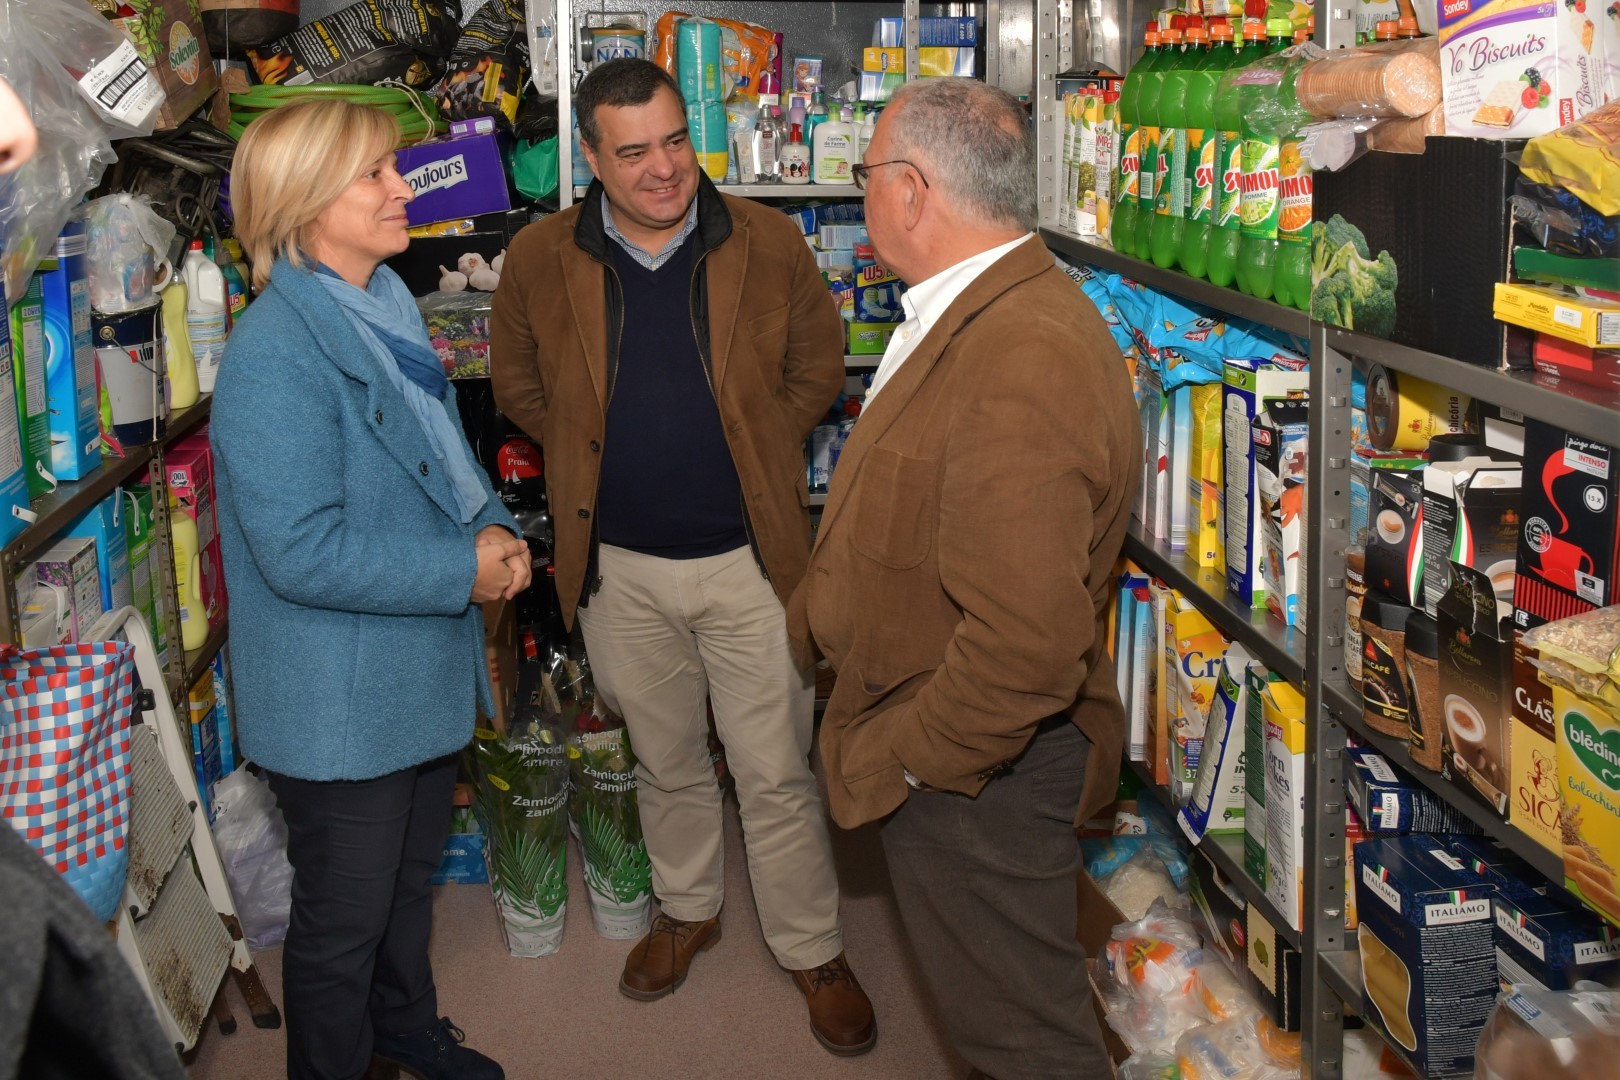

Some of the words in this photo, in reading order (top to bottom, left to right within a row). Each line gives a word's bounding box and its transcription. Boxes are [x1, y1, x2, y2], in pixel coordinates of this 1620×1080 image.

[1443, 0, 1469, 15] Sondey
[169, 39, 199, 71] Solevita
[597, 48, 637, 62] NAN
[1469, 33, 1546, 71] Biscuits
[1576, 54, 1593, 107] Biscuits
[1561, 100, 1572, 126] ondey
[1240, 169, 1279, 194] UMOL
[1244, 191, 1268, 200] POMME
[1282, 197, 1311, 206] ORANGE
[1448, 396, 1459, 432] chicória
[1578, 454, 1606, 469] INTENSO
[1587, 494, 1596, 502] 15
[1385, 796, 1393, 826] ITALIAMO
[1365, 870, 1398, 903] ITALIAMO
[1430, 904, 1486, 918] ITALIAMO
[1499, 915, 1540, 951] ITALIAMO
